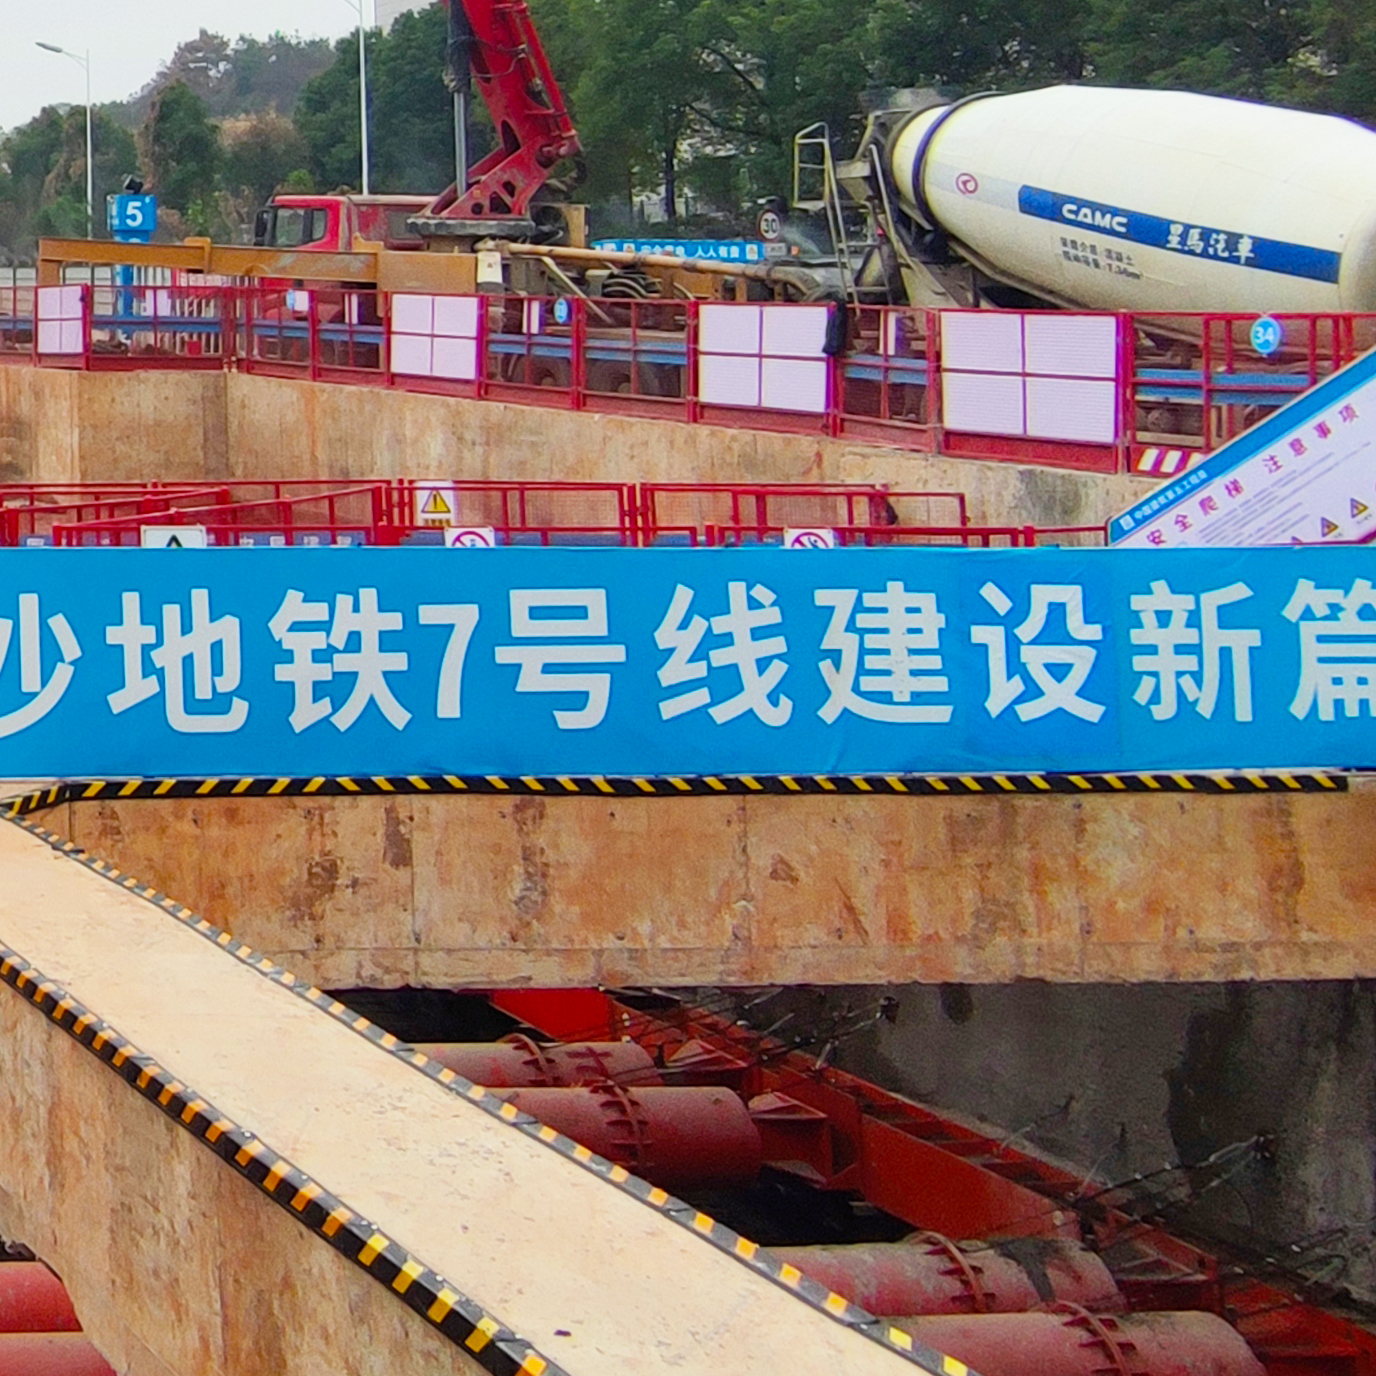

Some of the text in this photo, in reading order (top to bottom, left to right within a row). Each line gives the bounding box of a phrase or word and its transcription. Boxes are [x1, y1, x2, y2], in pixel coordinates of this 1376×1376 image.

[125, 201, 144, 227] 5
[1061, 203, 1129, 233] CAMC
[763, 218, 777, 234] 30
[1254, 326, 1275, 344] 34
